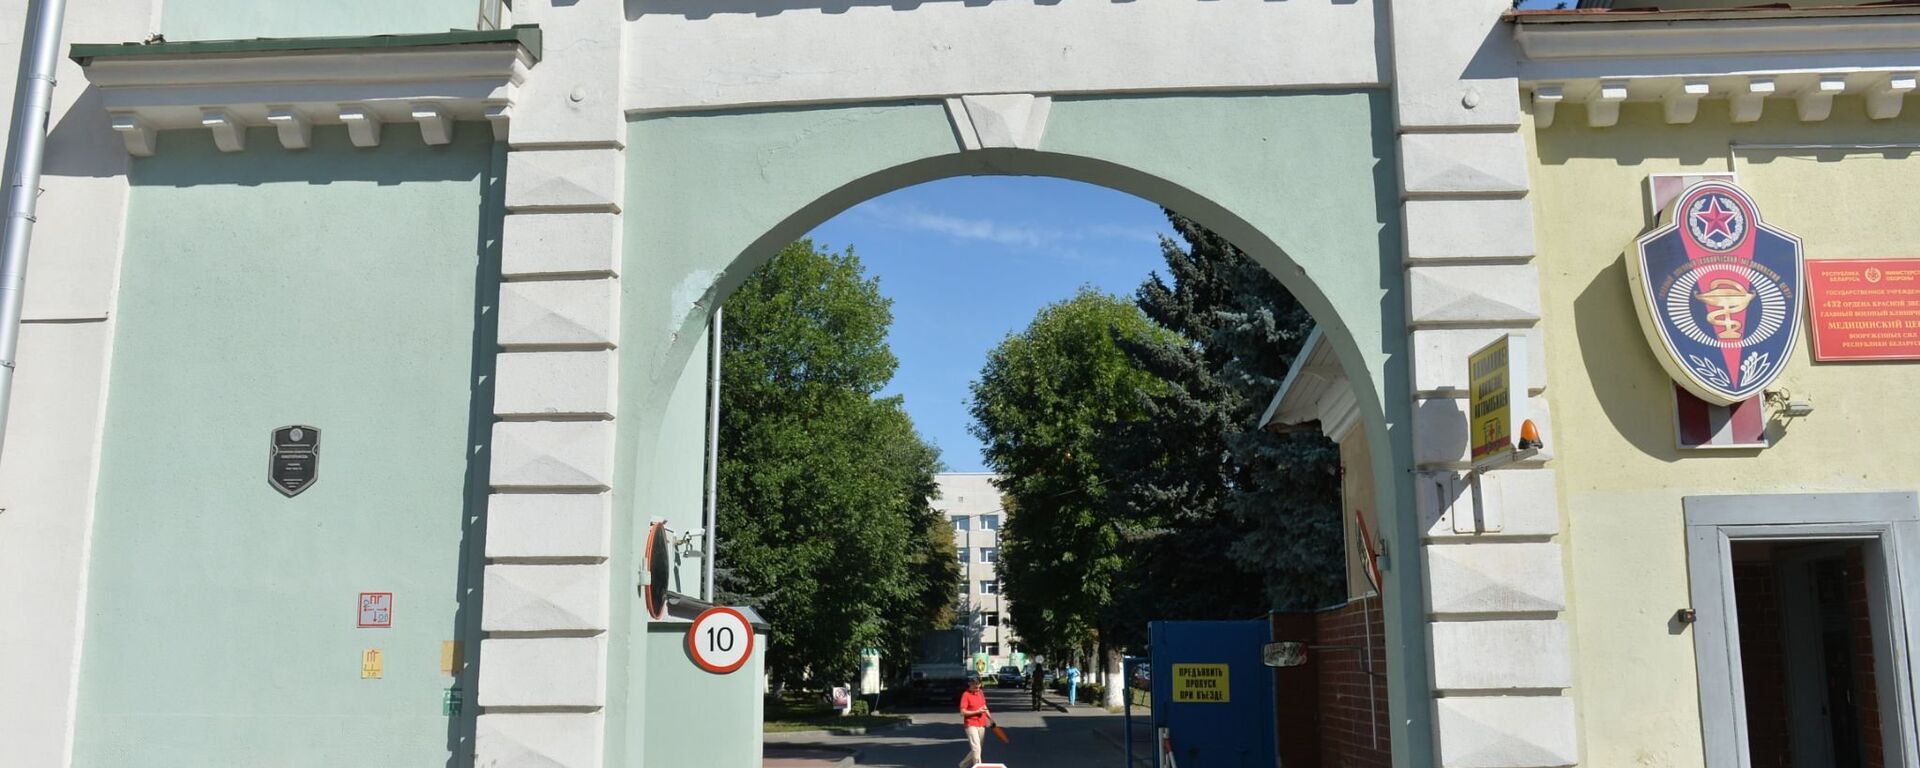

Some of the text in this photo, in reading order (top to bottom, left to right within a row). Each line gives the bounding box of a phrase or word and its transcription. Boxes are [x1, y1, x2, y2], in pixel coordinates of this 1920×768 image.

[1828, 320, 1902, 329] МЕДИЦИНСКИЙ
[707, 627, 734, 652] 10
[1179, 667, 1223, 677] ПРЕДЪЯВИТЬ
[1186, 679, 1216, 688] ПРОПУСК
[1180, 690, 1224, 700] ПРИ ВЪЕЗДЕ
